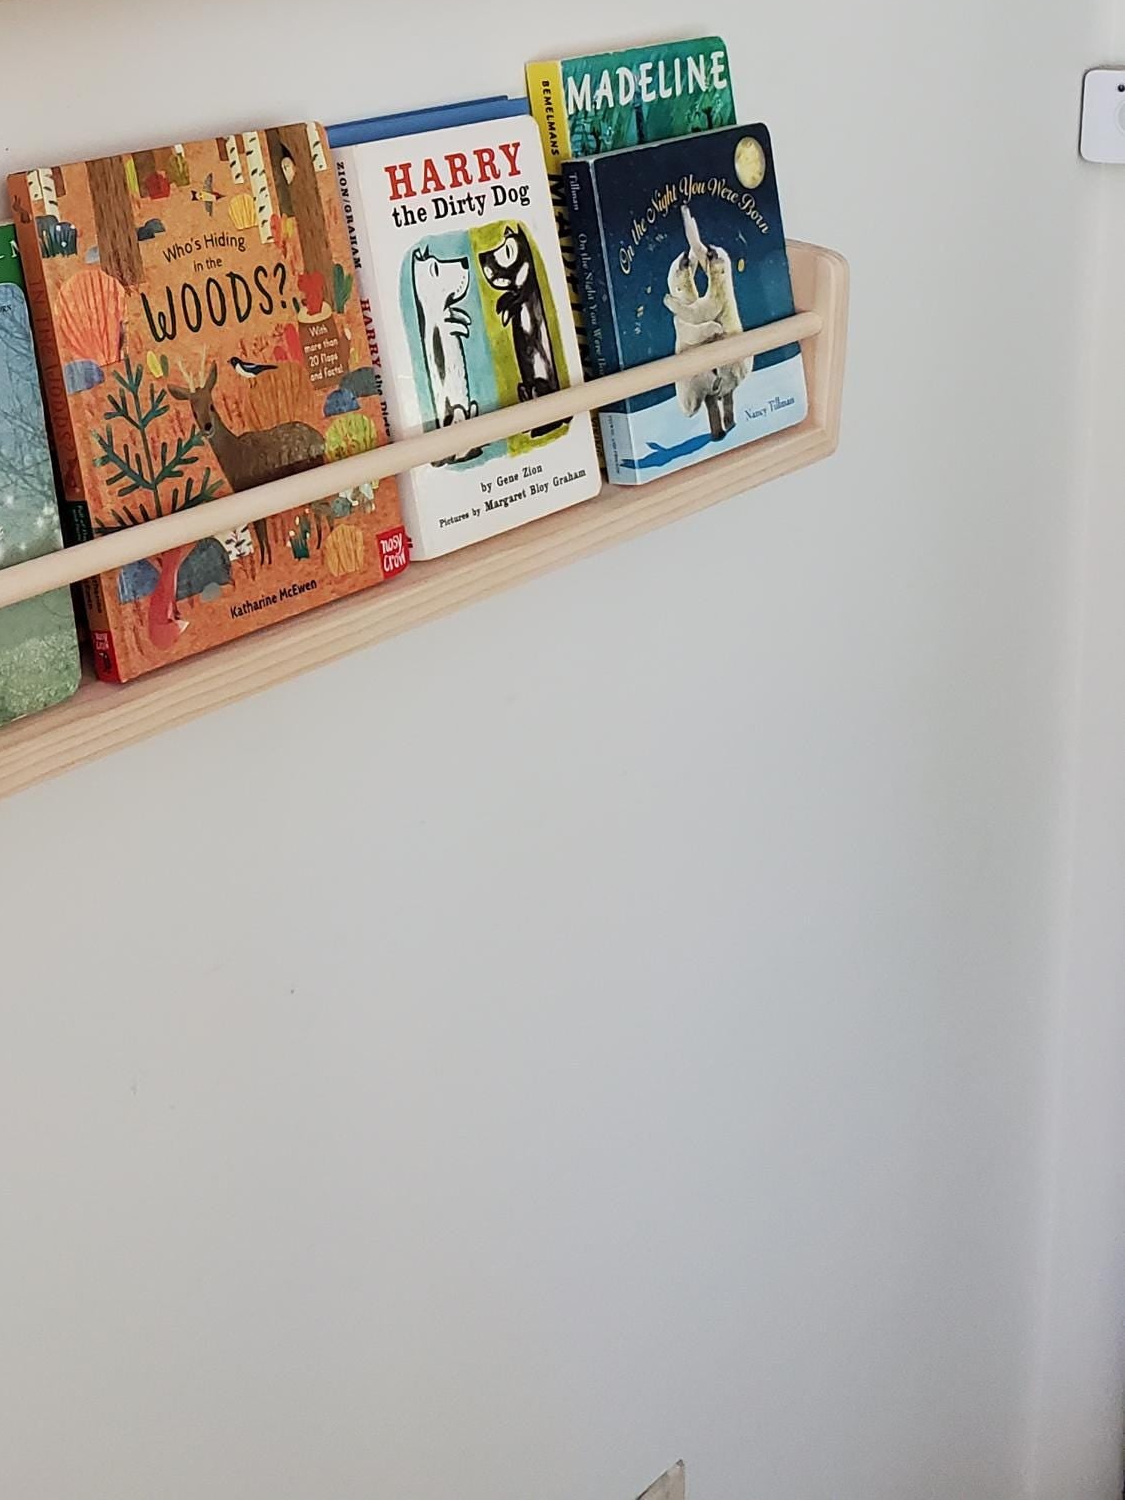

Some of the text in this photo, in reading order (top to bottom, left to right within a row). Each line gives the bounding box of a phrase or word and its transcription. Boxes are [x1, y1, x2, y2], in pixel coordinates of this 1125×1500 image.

[567, 51, 727, 116] MADELINE
[542, 80, 560, 157] BEMELMANS
[384, 141, 521, 200] HARRY
[391, 185, 531, 228] the Dirty Dog
[619, 174, 771, 275] On the Night You Were Born
[162, 232, 247, 263] Who's Hiding
[193, 257, 223, 273] in the
[568, 173, 603, 360] Tillman On the Night You Were
[141, 262, 287, 343] WOODS?
[304, 338, 339, 353] more than
[309, 324, 328, 337] With
[360, 300, 382, 368] HARRY
[309, 355, 320, 367] 20
[310, 369, 323, 381] and
[744, 396, 795, 421] Nancy Tillman
[480, 464, 543, 494] by Gene Zion
[439, 469, 587, 528] Pictures by Margaret Bloy Graham
[380, 533, 403, 555] nosy
[383, 548, 406, 572] crow
[230, 579, 317, 619] Katharine McEwen
